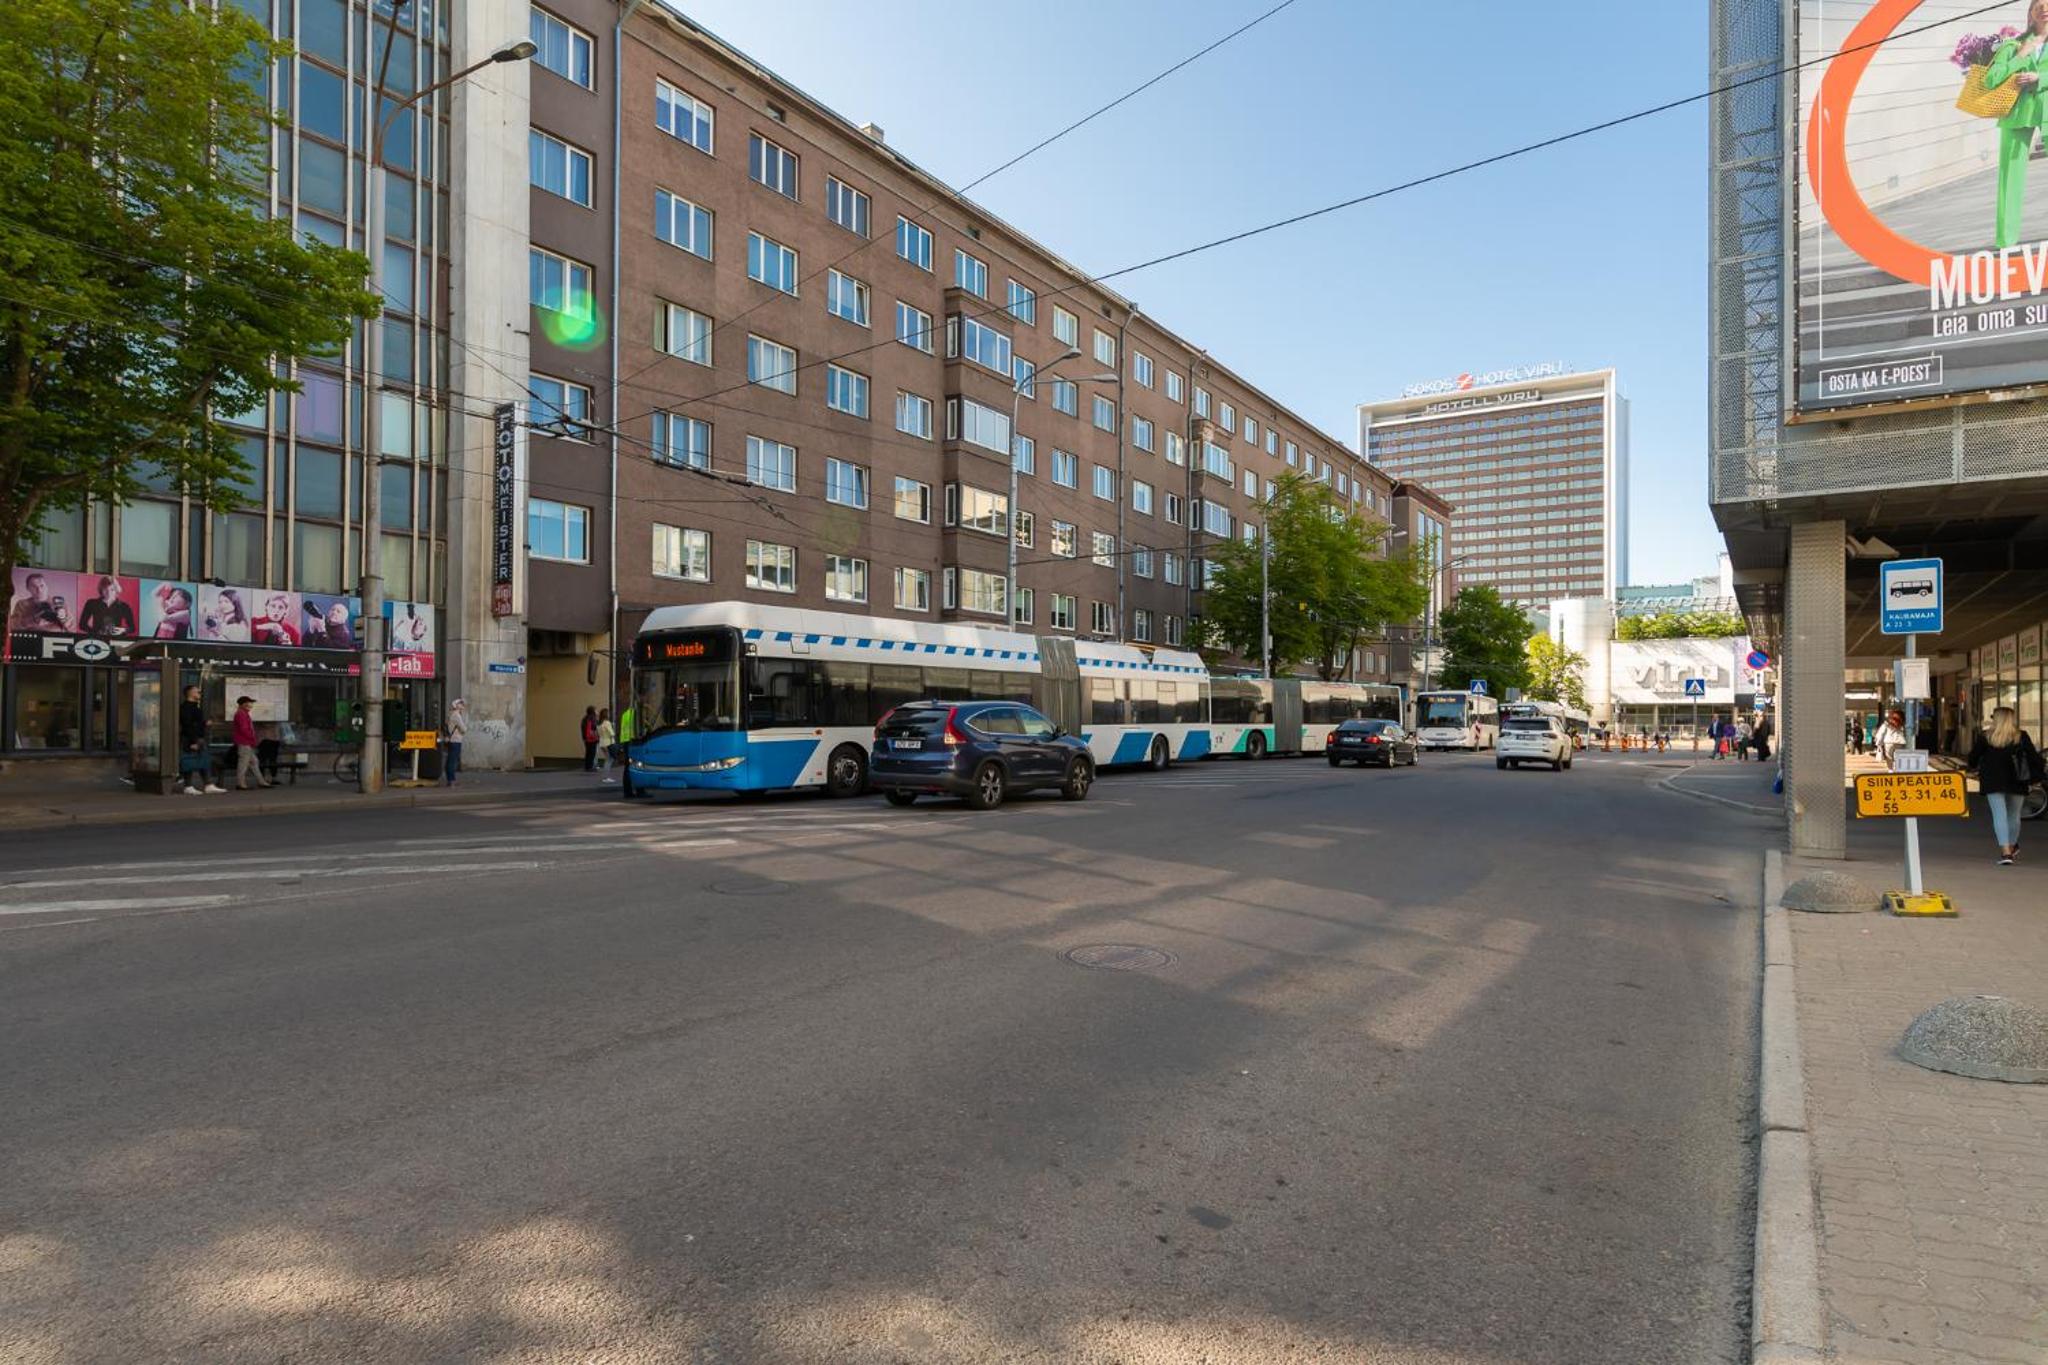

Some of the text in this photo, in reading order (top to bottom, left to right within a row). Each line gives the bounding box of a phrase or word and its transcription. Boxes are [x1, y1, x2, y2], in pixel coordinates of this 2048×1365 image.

[1932, 311, 1968, 338] Leia
[1977, 308, 2015, 331] oma
[1406, 360, 1562, 394] SOKOS HOTEL VIRU
[1829, 363, 1931, 392] OSTA KA E-POEST
[1425, 390, 1540, 413] HOTELL VIRU
[499, 412, 512, 579] FOTOMEISTER
[1867, 775, 1952, 787] SIIN PEATUB
[1863, 790, 1873, 801] B
[1883, 802, 1899, 814] 55
